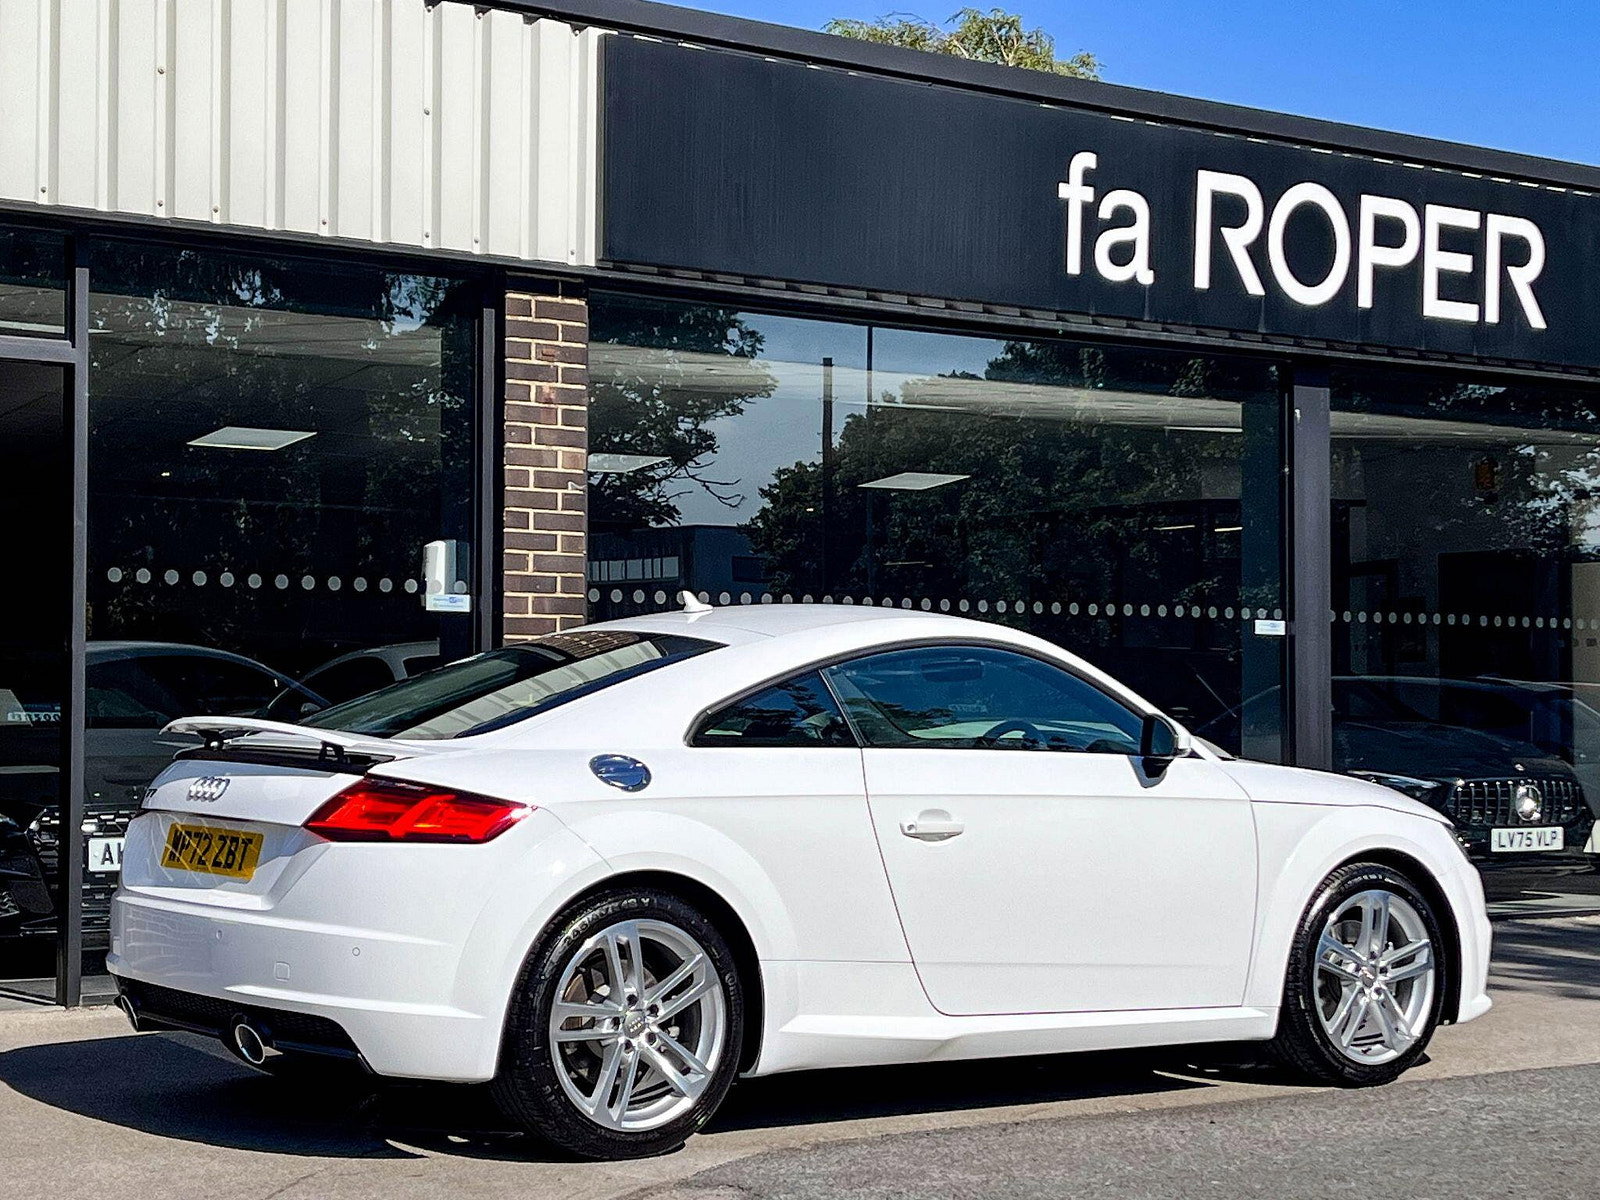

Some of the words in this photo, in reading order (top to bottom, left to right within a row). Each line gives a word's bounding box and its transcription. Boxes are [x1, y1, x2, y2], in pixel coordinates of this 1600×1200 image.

[1058, 151, 1154, 285] fa
[1194, 169, 1548, 330] ROPER
[211, 834, 254, 872] ZBT
[1498, 831, 1533, 848] LV75
